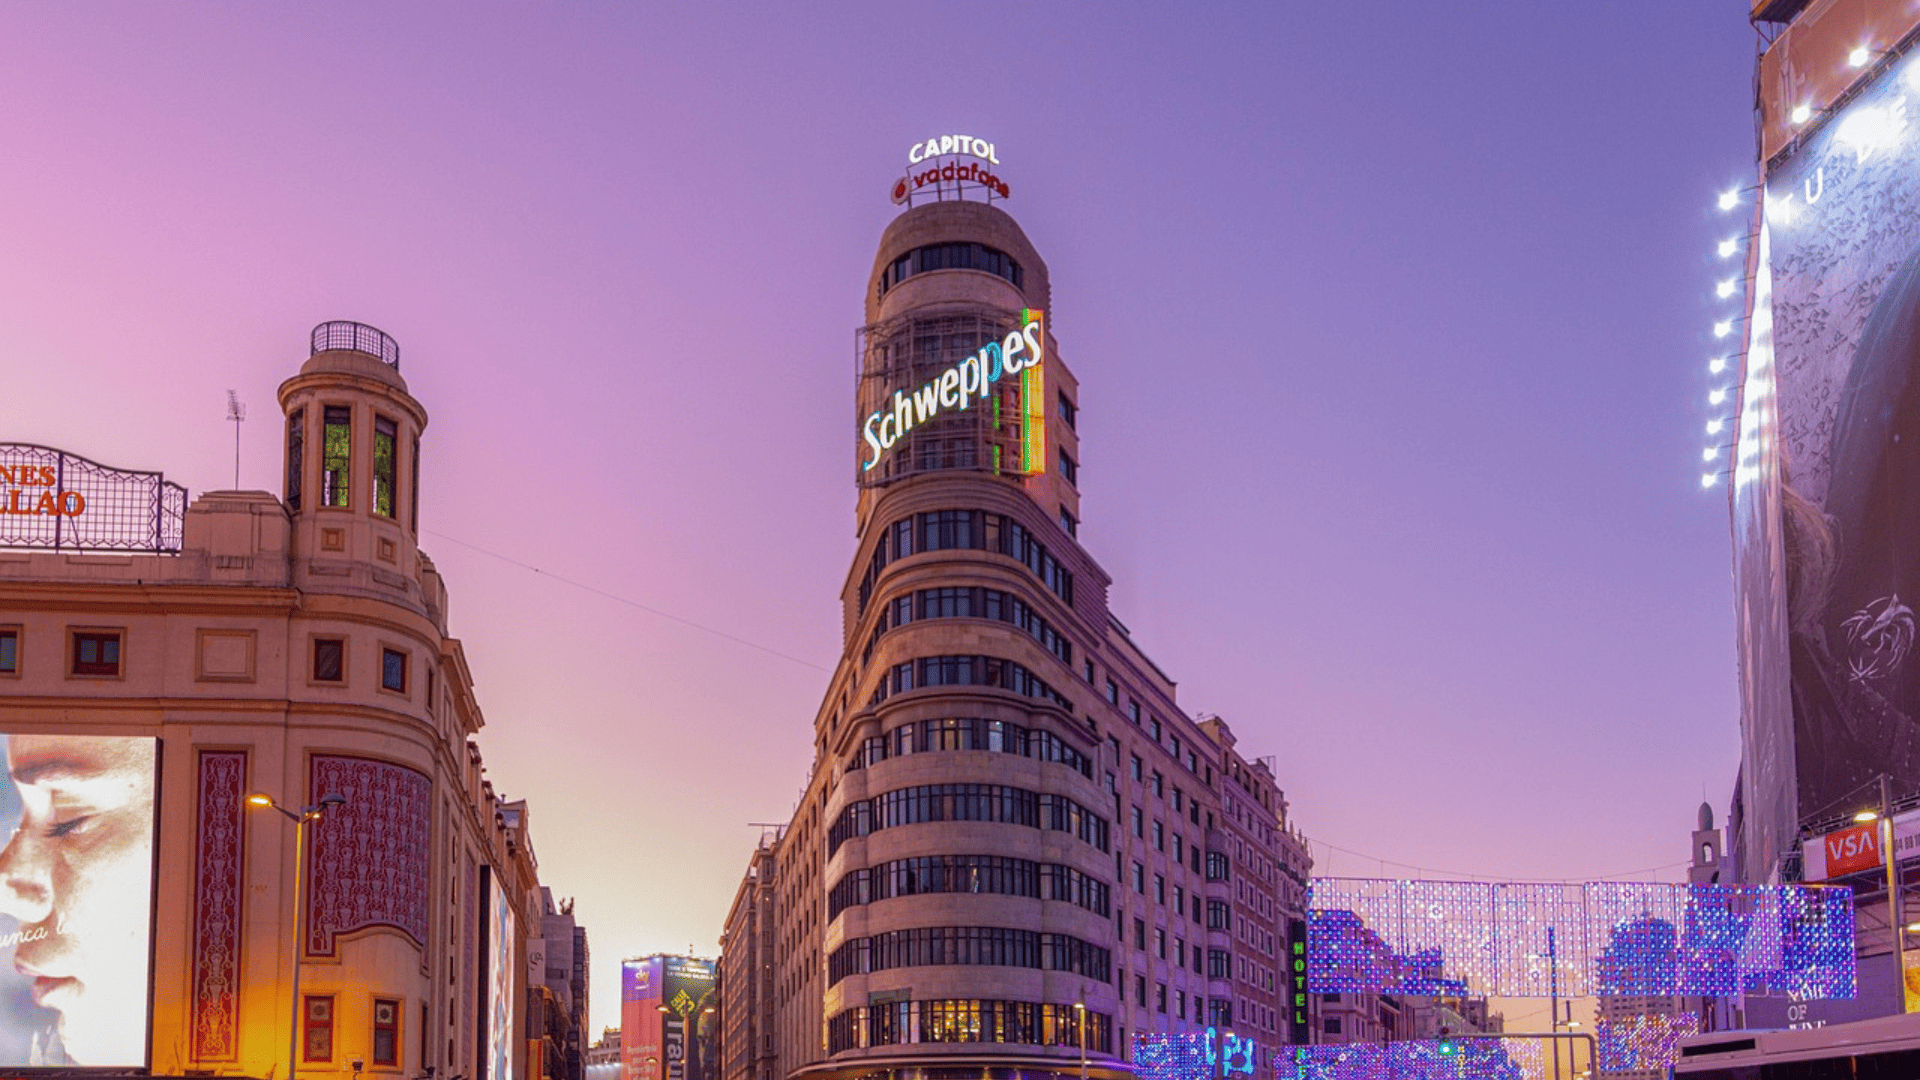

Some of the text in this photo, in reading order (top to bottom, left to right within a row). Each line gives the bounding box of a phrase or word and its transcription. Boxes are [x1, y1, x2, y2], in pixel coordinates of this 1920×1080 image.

[909, 135, 999, 165] CAPITOL
[864, 321, 1041, 471] Schweppes
[1293, 942, 1305, 1024] HOTEL
